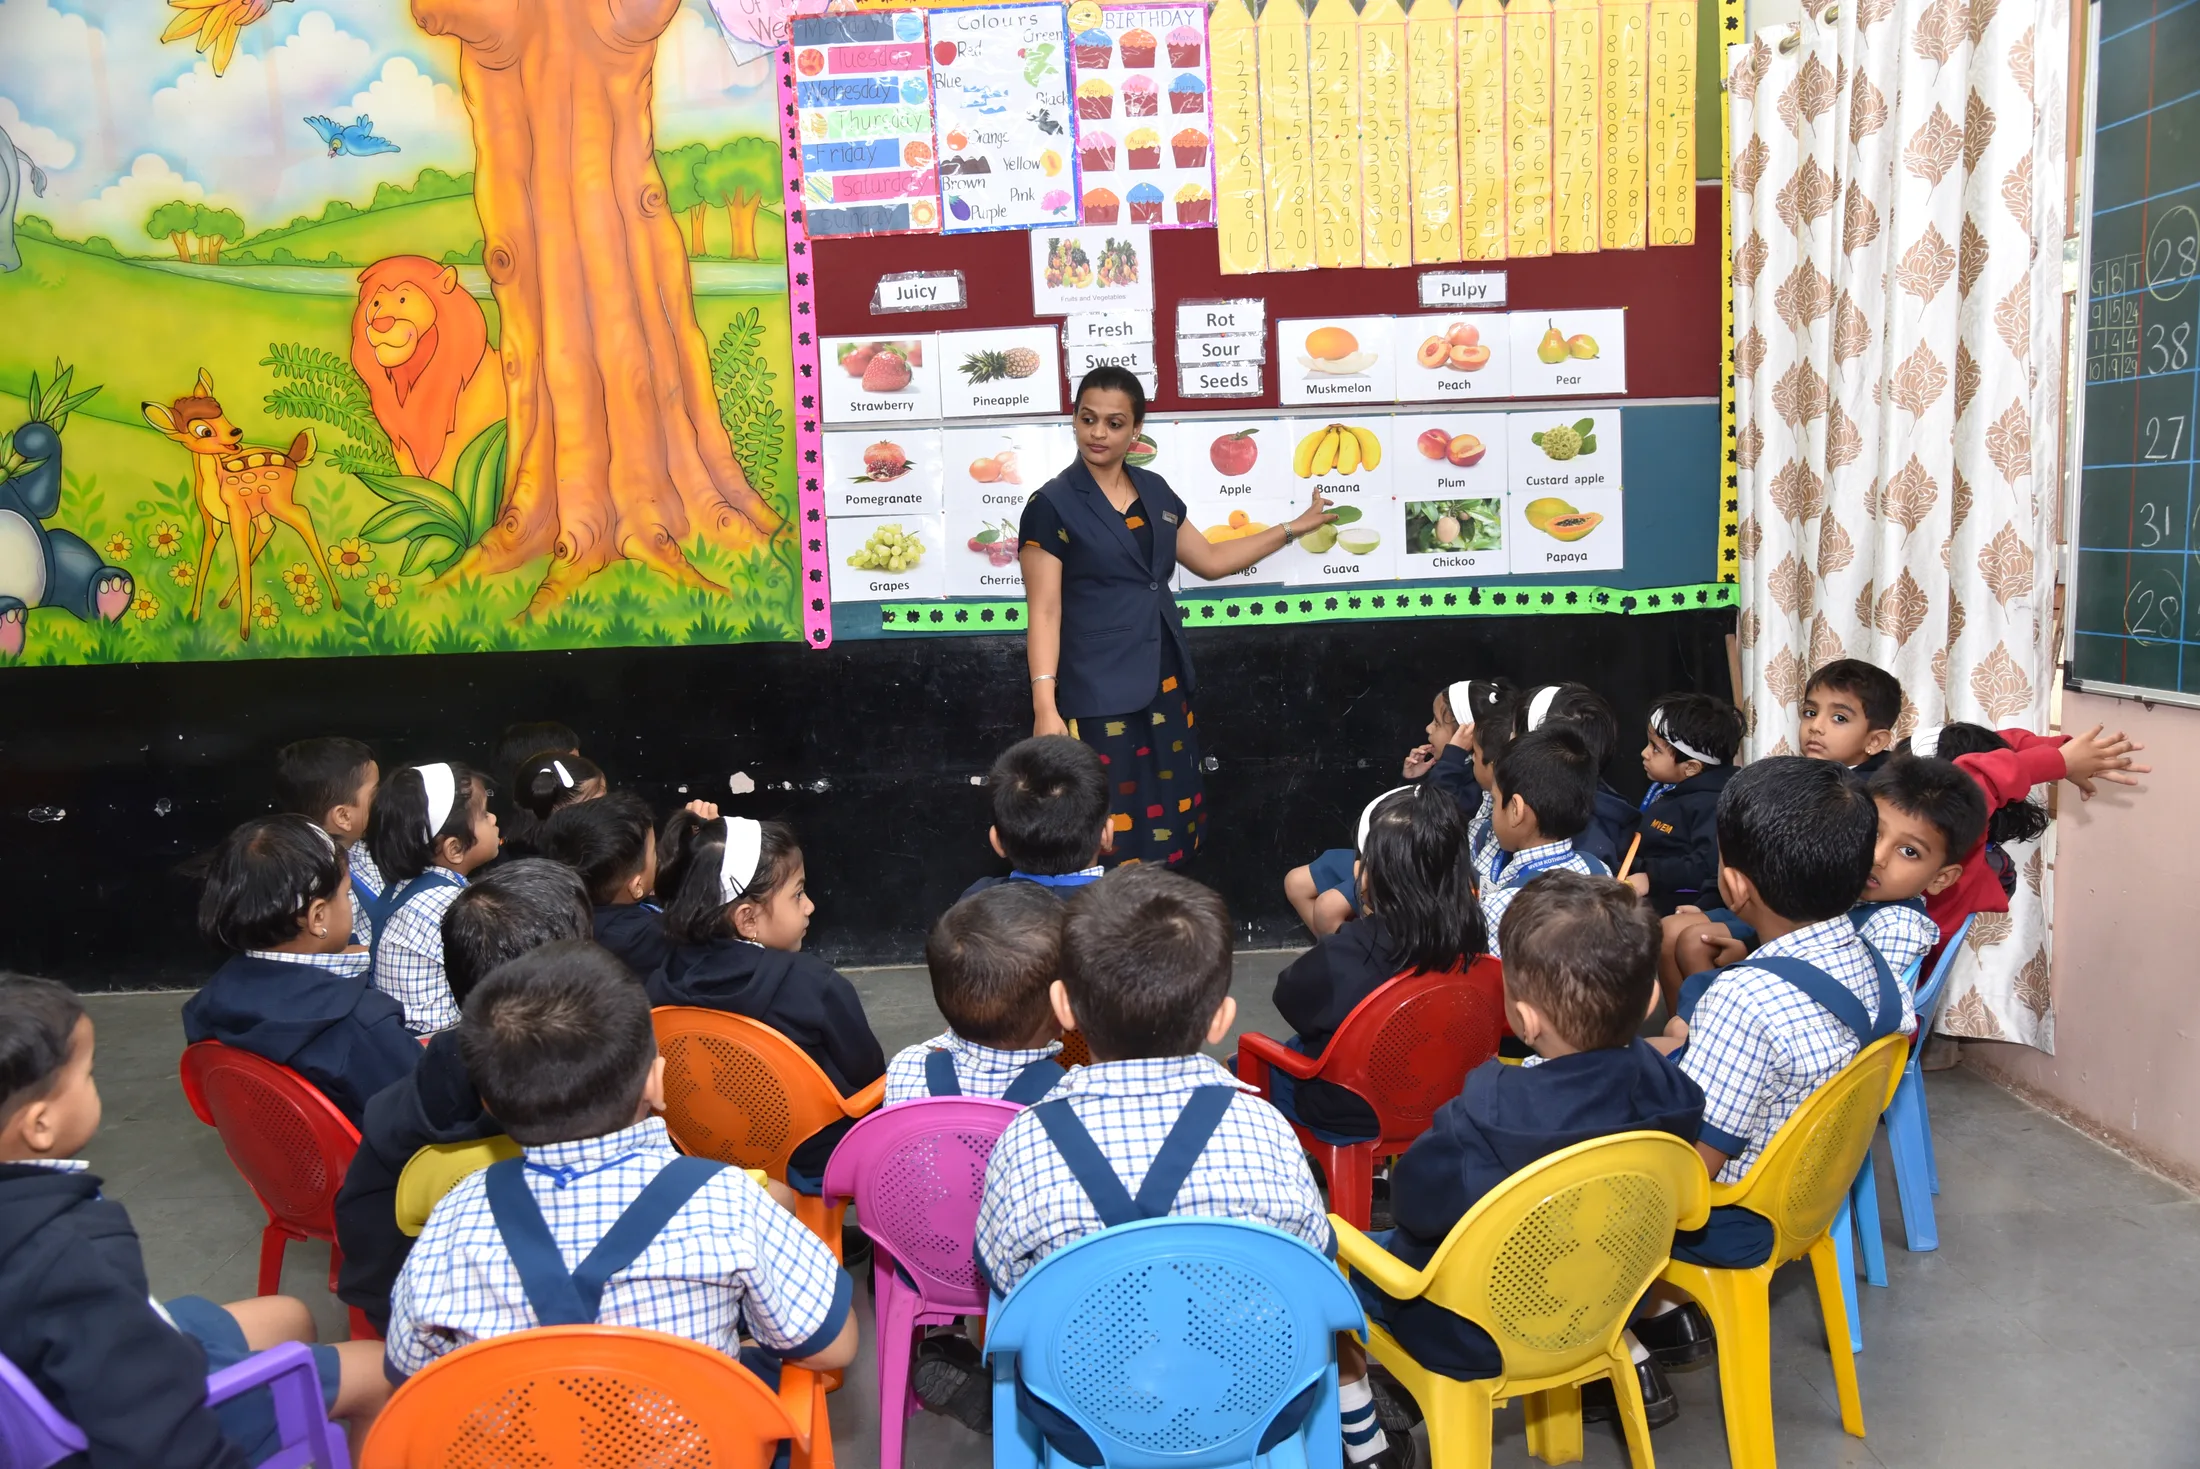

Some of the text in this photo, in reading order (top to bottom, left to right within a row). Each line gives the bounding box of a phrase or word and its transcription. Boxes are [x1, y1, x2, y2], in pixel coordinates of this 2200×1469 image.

[803, 15, 880, 40] Monday
[957, 14, 1038, 31] Colours
[1105, 9, 1195, 30] BIRTHDAY
[1023, 28, 1063, 43] Green
[957, 40, 982, 57] Red
[835, 48, 913, 69] Tuesday
[1236, 60, 1250, 76] 2
[934, 73, 962, 89] Blue
[802, 79, 892, 102] Wednesday
[1238, 80, 1248, 100] 3
[1036, 91, 1069, 106] Black
[1238, 102, 1250, 120] 4
[835, 107, 922, 132] Thursday
[968, 129, 1010, 149] Orange
[1239, 124, 1251, 144] 5
[816, 143, 877, 167] Friday
[1240, 147, 1251, 166] 6
[1003, 156, 1041, 171] Yellow
[841, 172, 929, 197] Saturday
[942, 176, 986, 191] Brown
[1243, 170, 1252, 187] 7
[1010, 187, 1035, 202] Pink
[1244, 190, 1254, 208] 8
[820, 207, 894, 230] Sunday
[971, 204, 1008, 224] Purple
[1245, 210, 1254, 229] 9
[2150, 236, 2196, 287] 28
[2091, 261, 2144, 296] G B T
[896, 284, 937, 300] Juicy
[1092, 293, 1127, 301] Vegetables
[1441, 281, 1487, 299] Pulpy
[1206, 313, 1235, 327] Rot
[2092, 299, 2139, 325] 9 15 24
[1088, 321, 1133, 337] Fresh
[2111, 332, 2120, 352] 4
[2126, 328, 2138, 349] 4
[1202, 343, 1240, 357] Sour
[2146, 321, 2191, 376] 38
[1085, 353, 1138, 369] Sweet
[2089, 361, 2101, 381] 10
[2124, 356, 2138, 379] 29
[1200, 372, 1249, 388] Seeds
[1306, 382, 1372, 394] Muskmelon
[1438, 379, 1471, 391] Peach
[1556, 375, 1581, 385] Pear
[850, 400, 914, 412] Strawberry
[973, 393, 1030, 407] Pineapple
[2144, 415, 2186, 460] 27
[1437, 477, 1466, 488] Plum
[1526, 473, 1605, 487] Custard apple
[1219, 483, 1252, 496] Apple
[1316, 484, 1360, 494] Banana
[845, 494, 923, 506] Pomegranate
[982, 494, 1024, 505] Orange
[2140, 502, 2170, 547] 31
[1432, 556, 1476, 568] Chickoo
[1546, 551, 1588, 565] Papaya
[1323, 564, 1360, 575] Guava
[869, 581, 910, 593] Grapes
[980, 575, 1025, 585] Cherries
[2132, 589, 2179, 639] 28
